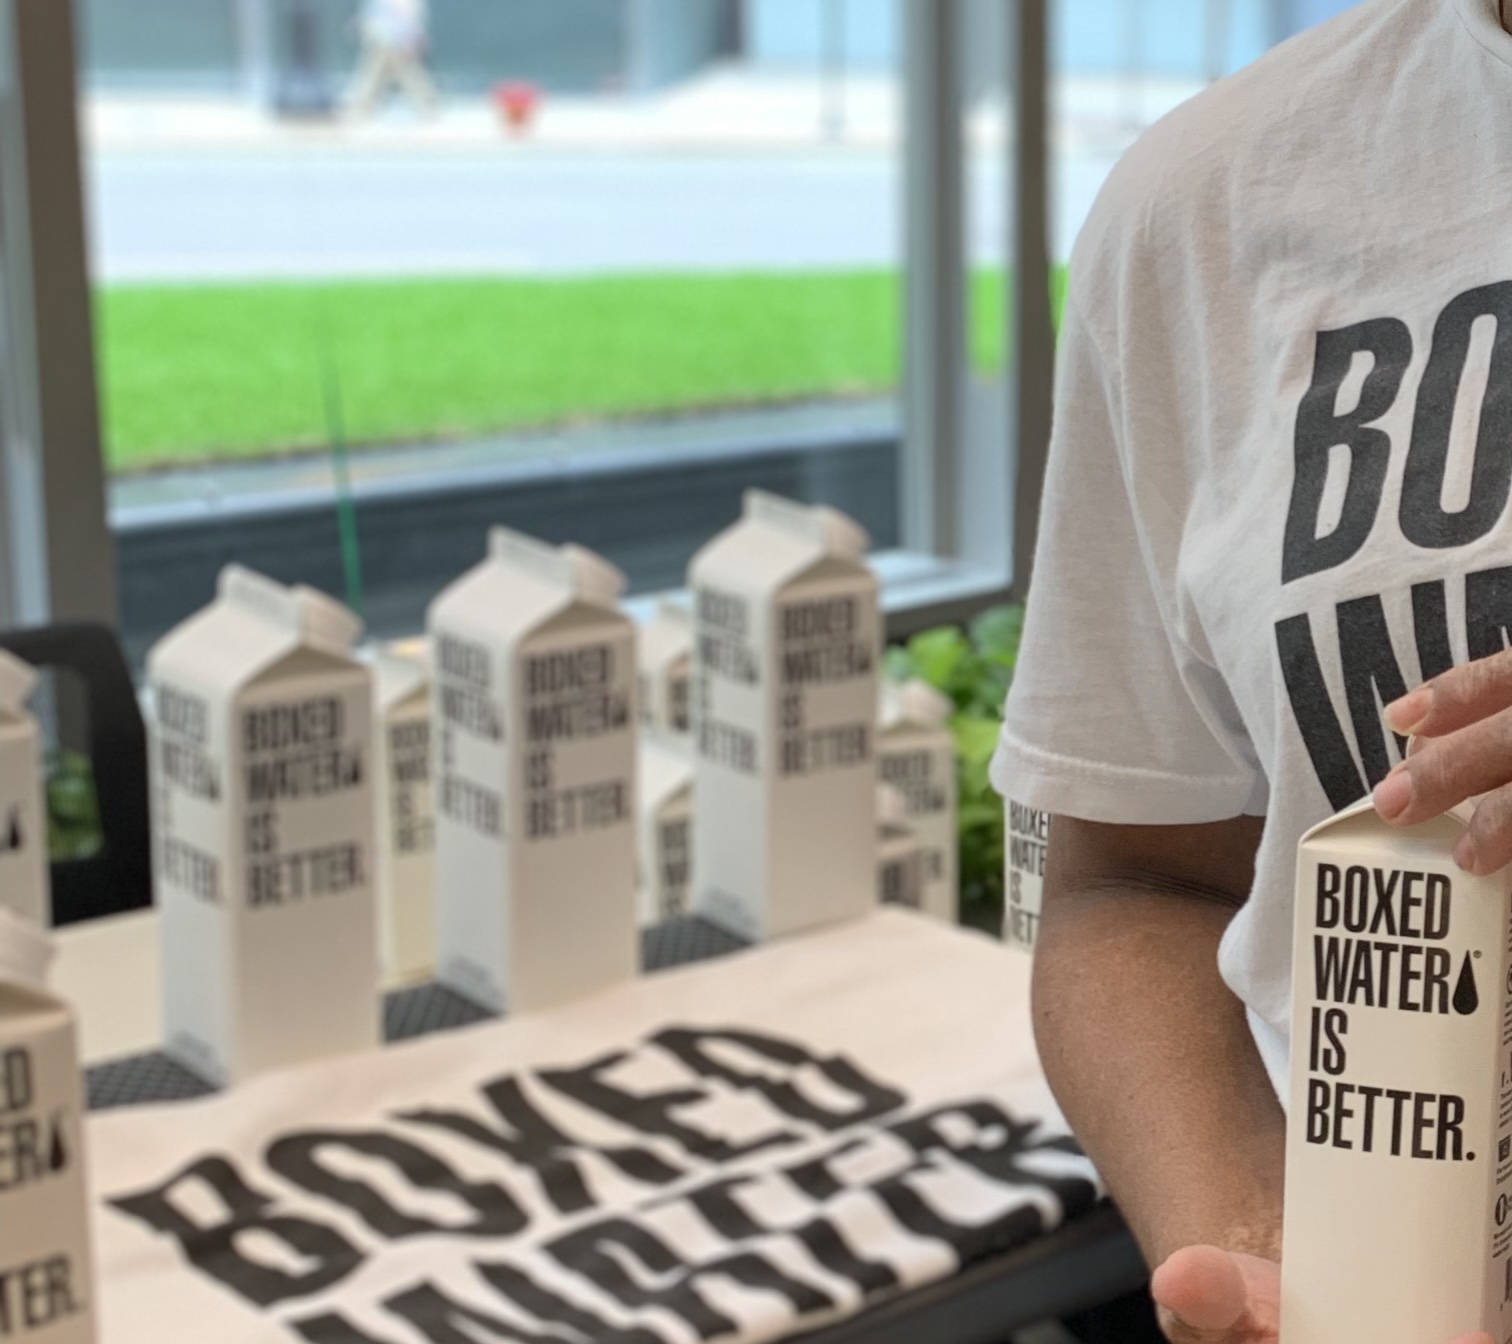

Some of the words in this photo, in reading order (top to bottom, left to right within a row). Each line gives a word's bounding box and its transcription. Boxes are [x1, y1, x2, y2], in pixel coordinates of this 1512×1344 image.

[1315, 863, 1451, 940] BOXED
[1313, 935, 1450, 1014] WATER
[1309, 1007, 1348, 1076] IS
[1306, 1079, 1476, 1162] BETTER.
[104, 1023, 909, 1309] BOXED
